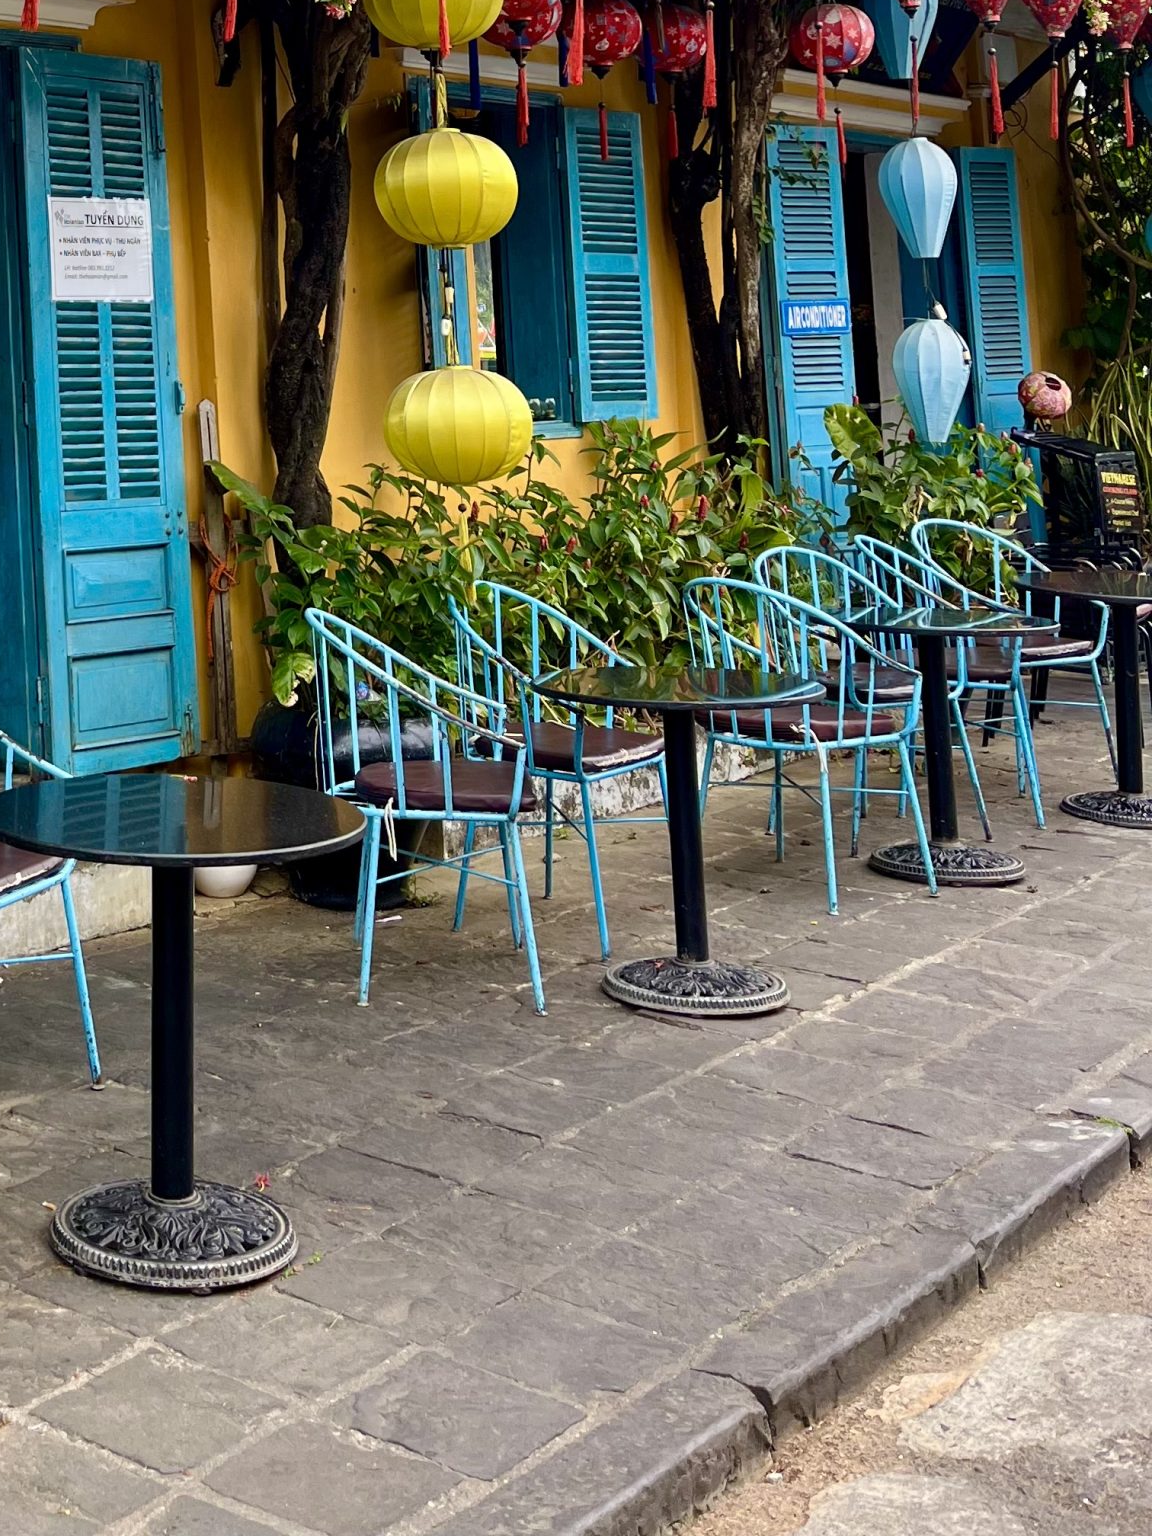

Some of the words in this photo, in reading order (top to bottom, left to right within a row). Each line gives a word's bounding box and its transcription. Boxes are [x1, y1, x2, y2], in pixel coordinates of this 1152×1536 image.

[117, 214, 144, 227] DỤNG
[63, 248, 78, 257] NHÂN
[788, 305, 847, 329] AIRCONDITIONER
[1101, 471, 1136, 485] VIETNAMESE
